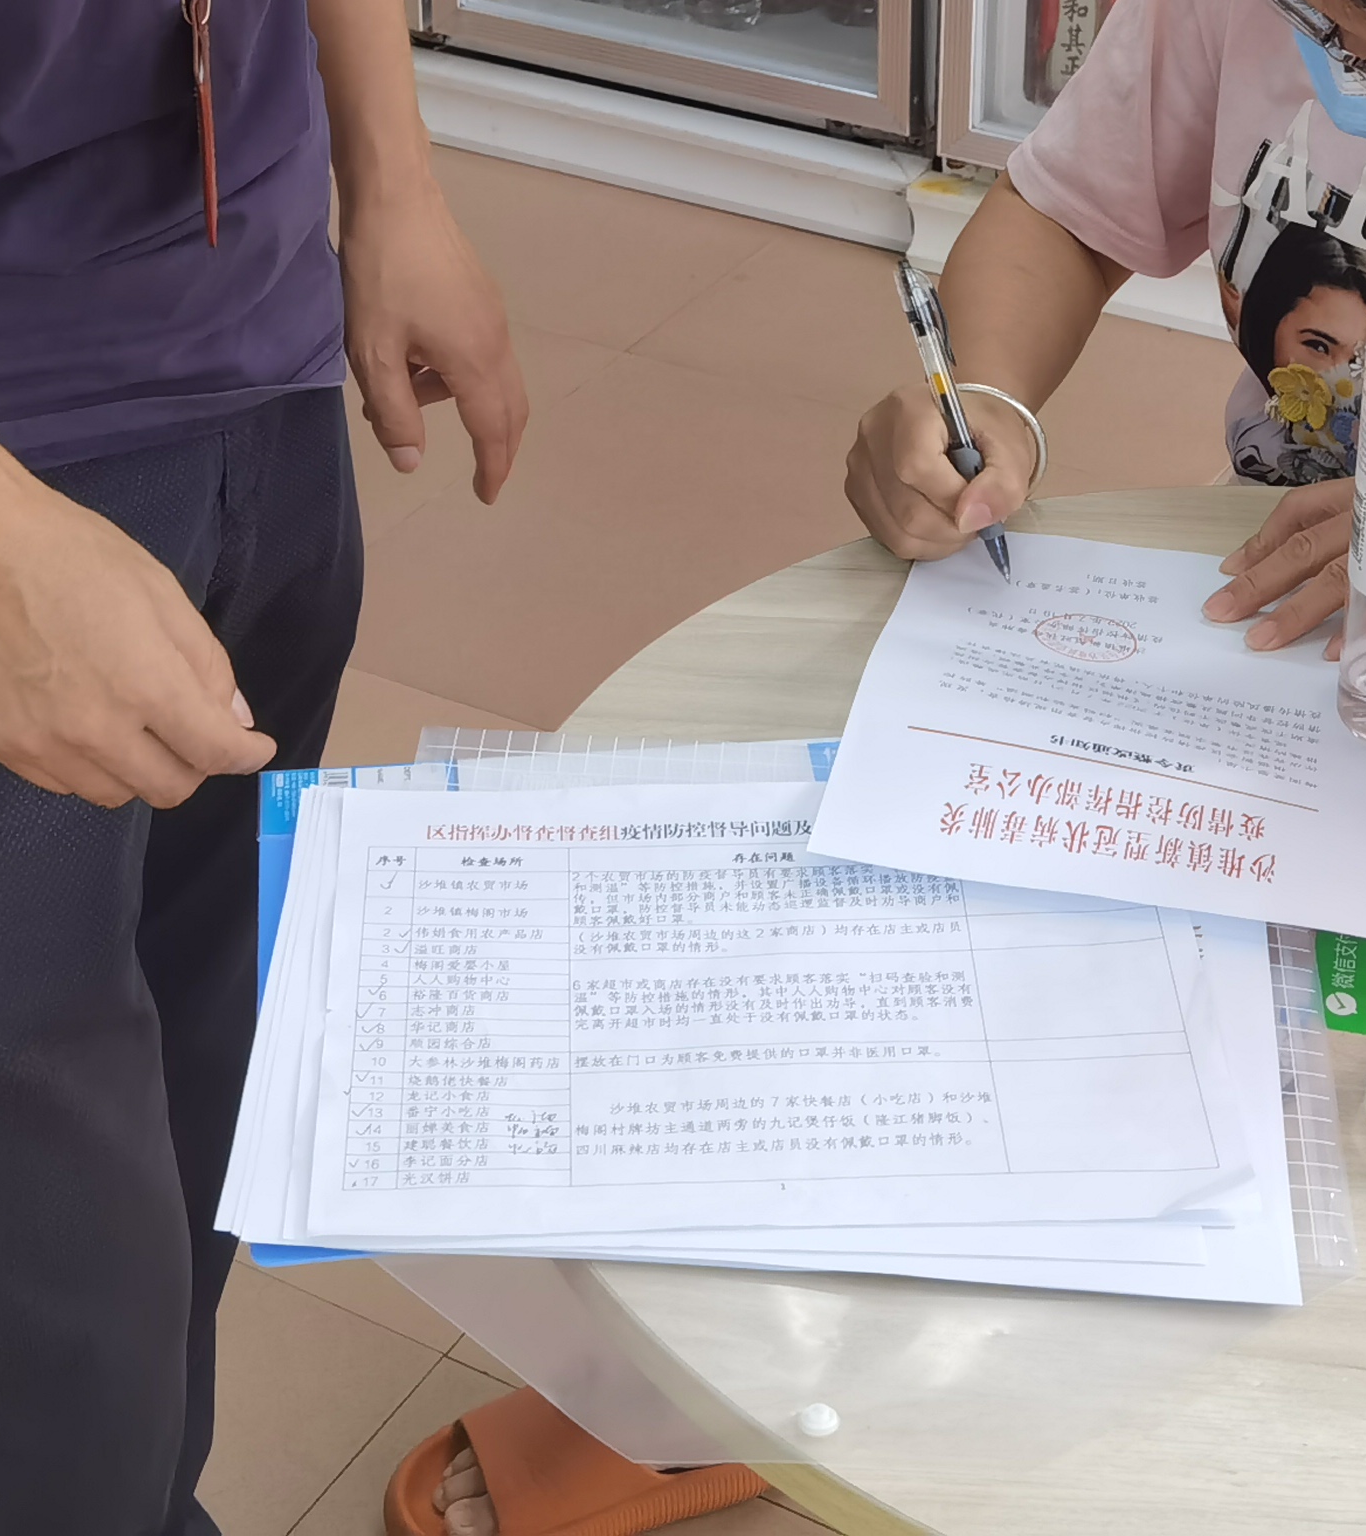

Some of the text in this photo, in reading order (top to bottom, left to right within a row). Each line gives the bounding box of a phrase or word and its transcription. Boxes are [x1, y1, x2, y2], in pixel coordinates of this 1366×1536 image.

[963, 762, 1267, 842] 疫情防控指挥部办公室
[939, 801, 1278, 884] 沙堆镇新型冠状病毒肺炎
[375, 851, 796, 868] 序号 检查场所 存在问题
[417, 879, 529, 891] 沙堆镇农贸市场
[416, 906, 529, 919] 沙堆镇梅阁市场
[413, 974, 511, 986] 人人购物中心
[410, 1021, 475, 1034] 华记商店
